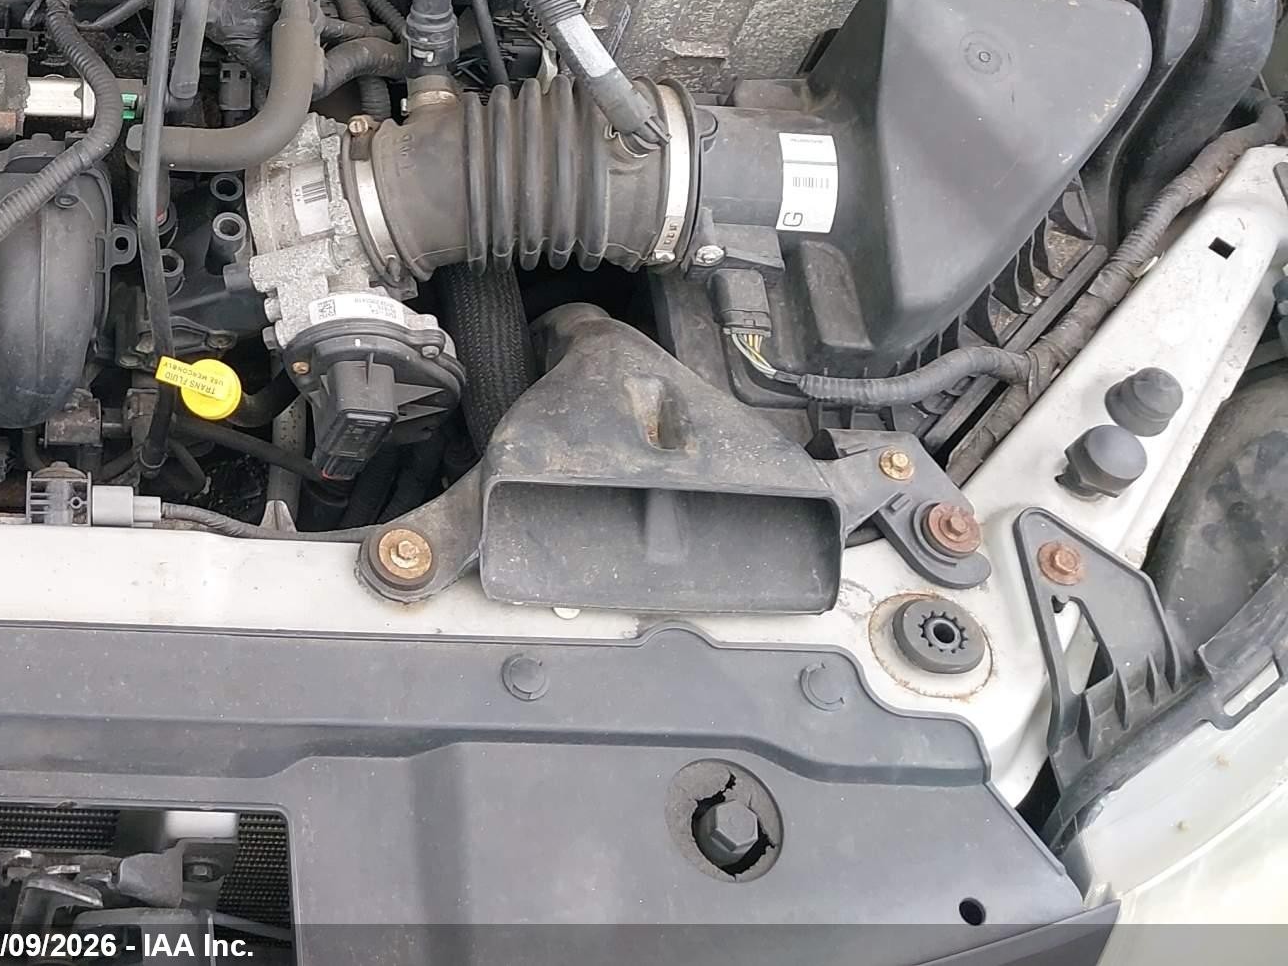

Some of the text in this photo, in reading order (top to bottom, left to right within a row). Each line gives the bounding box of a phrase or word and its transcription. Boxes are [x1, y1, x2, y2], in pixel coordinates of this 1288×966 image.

[782, 211, 804, 227] G
[164, 371, 216, 395] TRANS FLUID
[210, 376, 225, 387] USE
